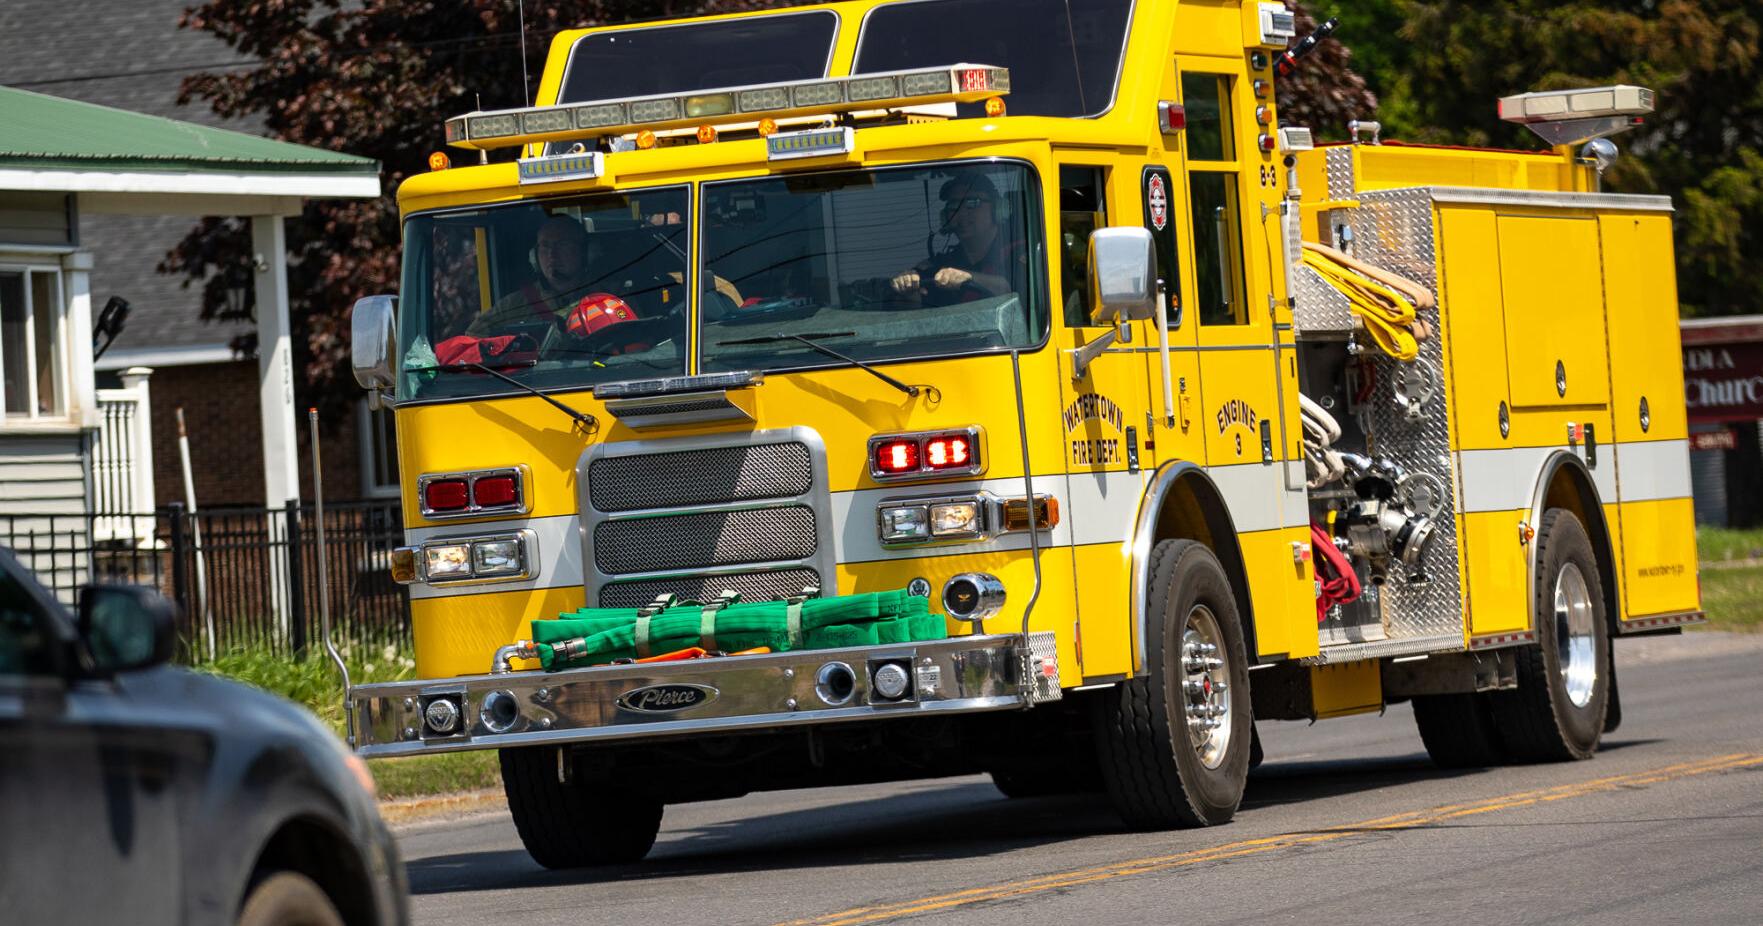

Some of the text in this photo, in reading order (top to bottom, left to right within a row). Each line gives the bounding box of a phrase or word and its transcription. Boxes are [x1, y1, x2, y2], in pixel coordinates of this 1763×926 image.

[1064, 393, 1122, 433] WATERTOWN
[1216, 399, 1256, 435] ENGINE
[1073, 439, 1121, 465] FIRE DEPT.
[1235, 432, 1242, 455] 3
[637, 687, 698, 710] Pierce
